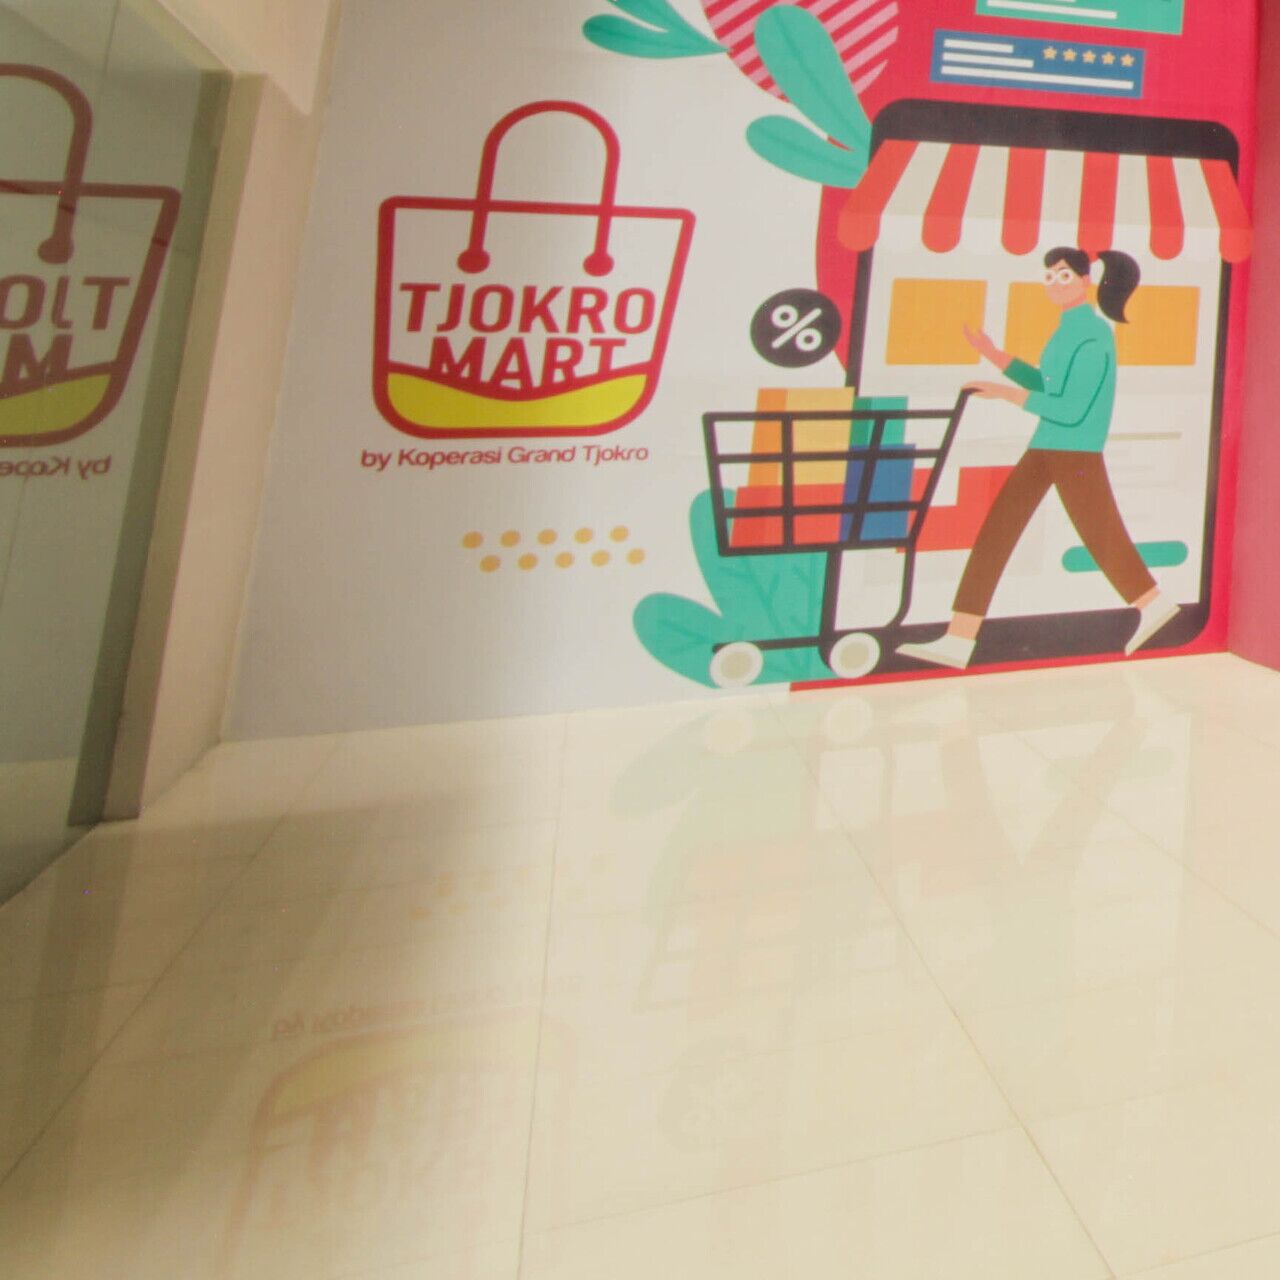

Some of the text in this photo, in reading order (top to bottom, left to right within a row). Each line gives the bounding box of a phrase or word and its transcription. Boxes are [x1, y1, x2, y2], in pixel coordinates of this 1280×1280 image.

[400, 282, 656, 335] TJOKRO
[428, 335, 627, 391] MART
[361, 444, 649, 471] by Koperasi Grand Tjokro
